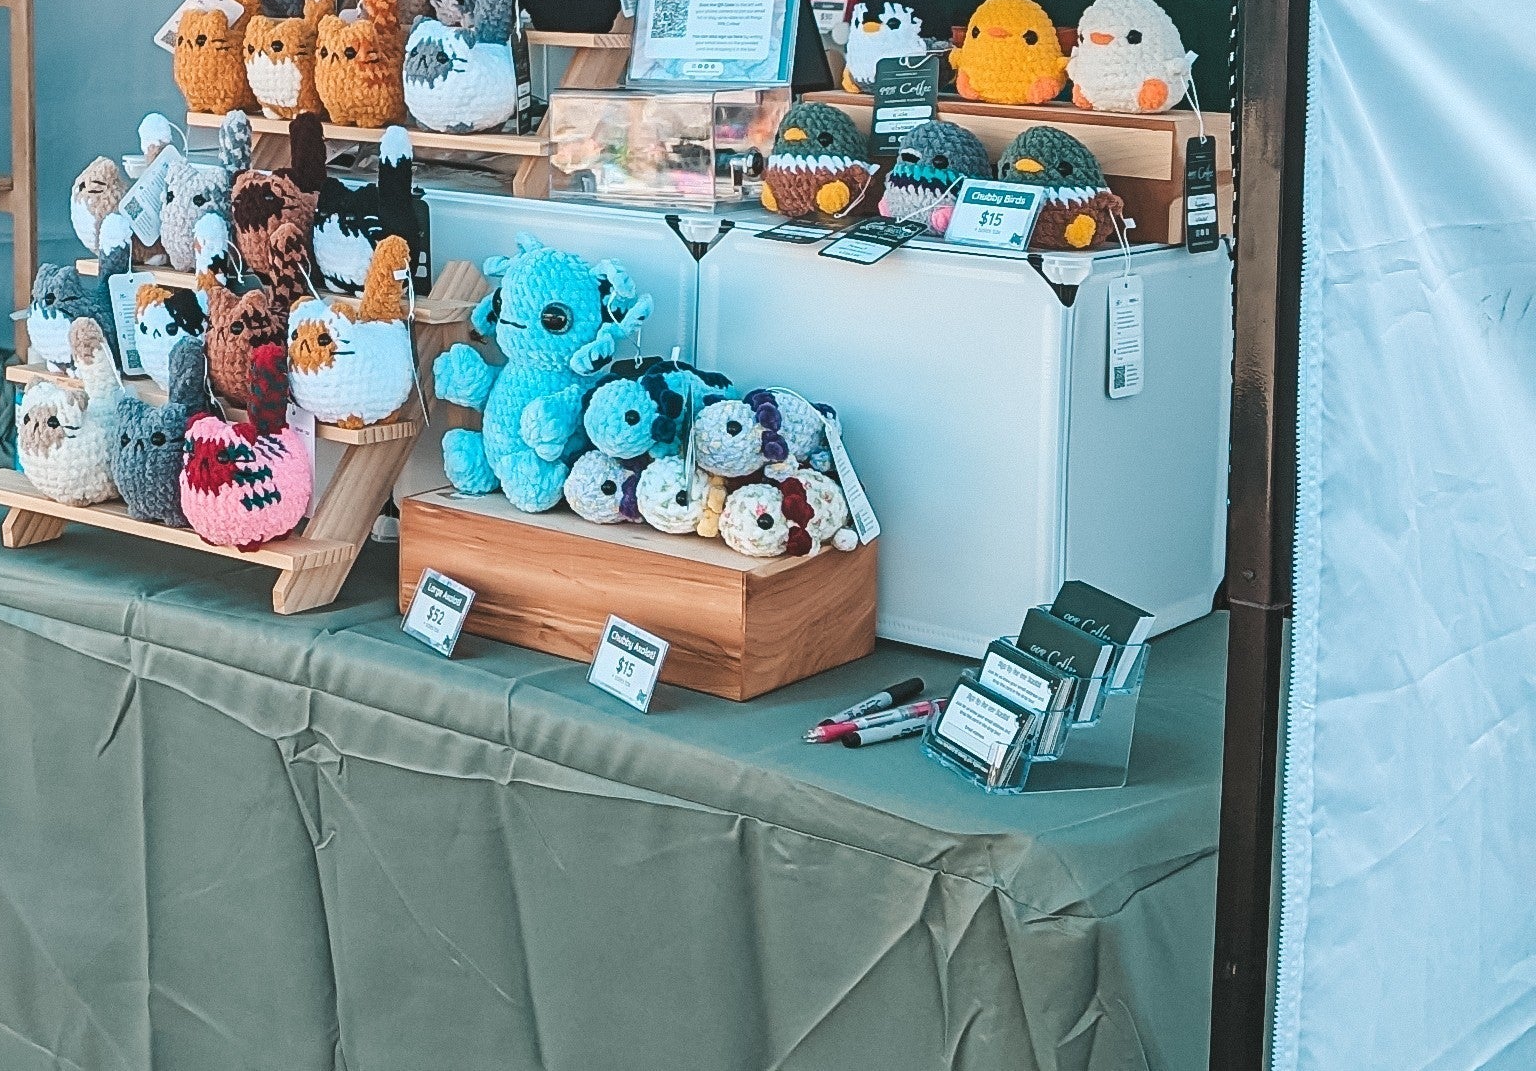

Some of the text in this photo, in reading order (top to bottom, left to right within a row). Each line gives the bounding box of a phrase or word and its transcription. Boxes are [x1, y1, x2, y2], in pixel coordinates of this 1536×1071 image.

[971, 191, 1026, 206] Chubby Birds
[978, 210, 1003, 227] $15
[427, 582, 445, 600] Large
[426, 604, 446, 626] $52
[611, 630, 634, 651] Chubby
[615, 655, 637, 678] $15
